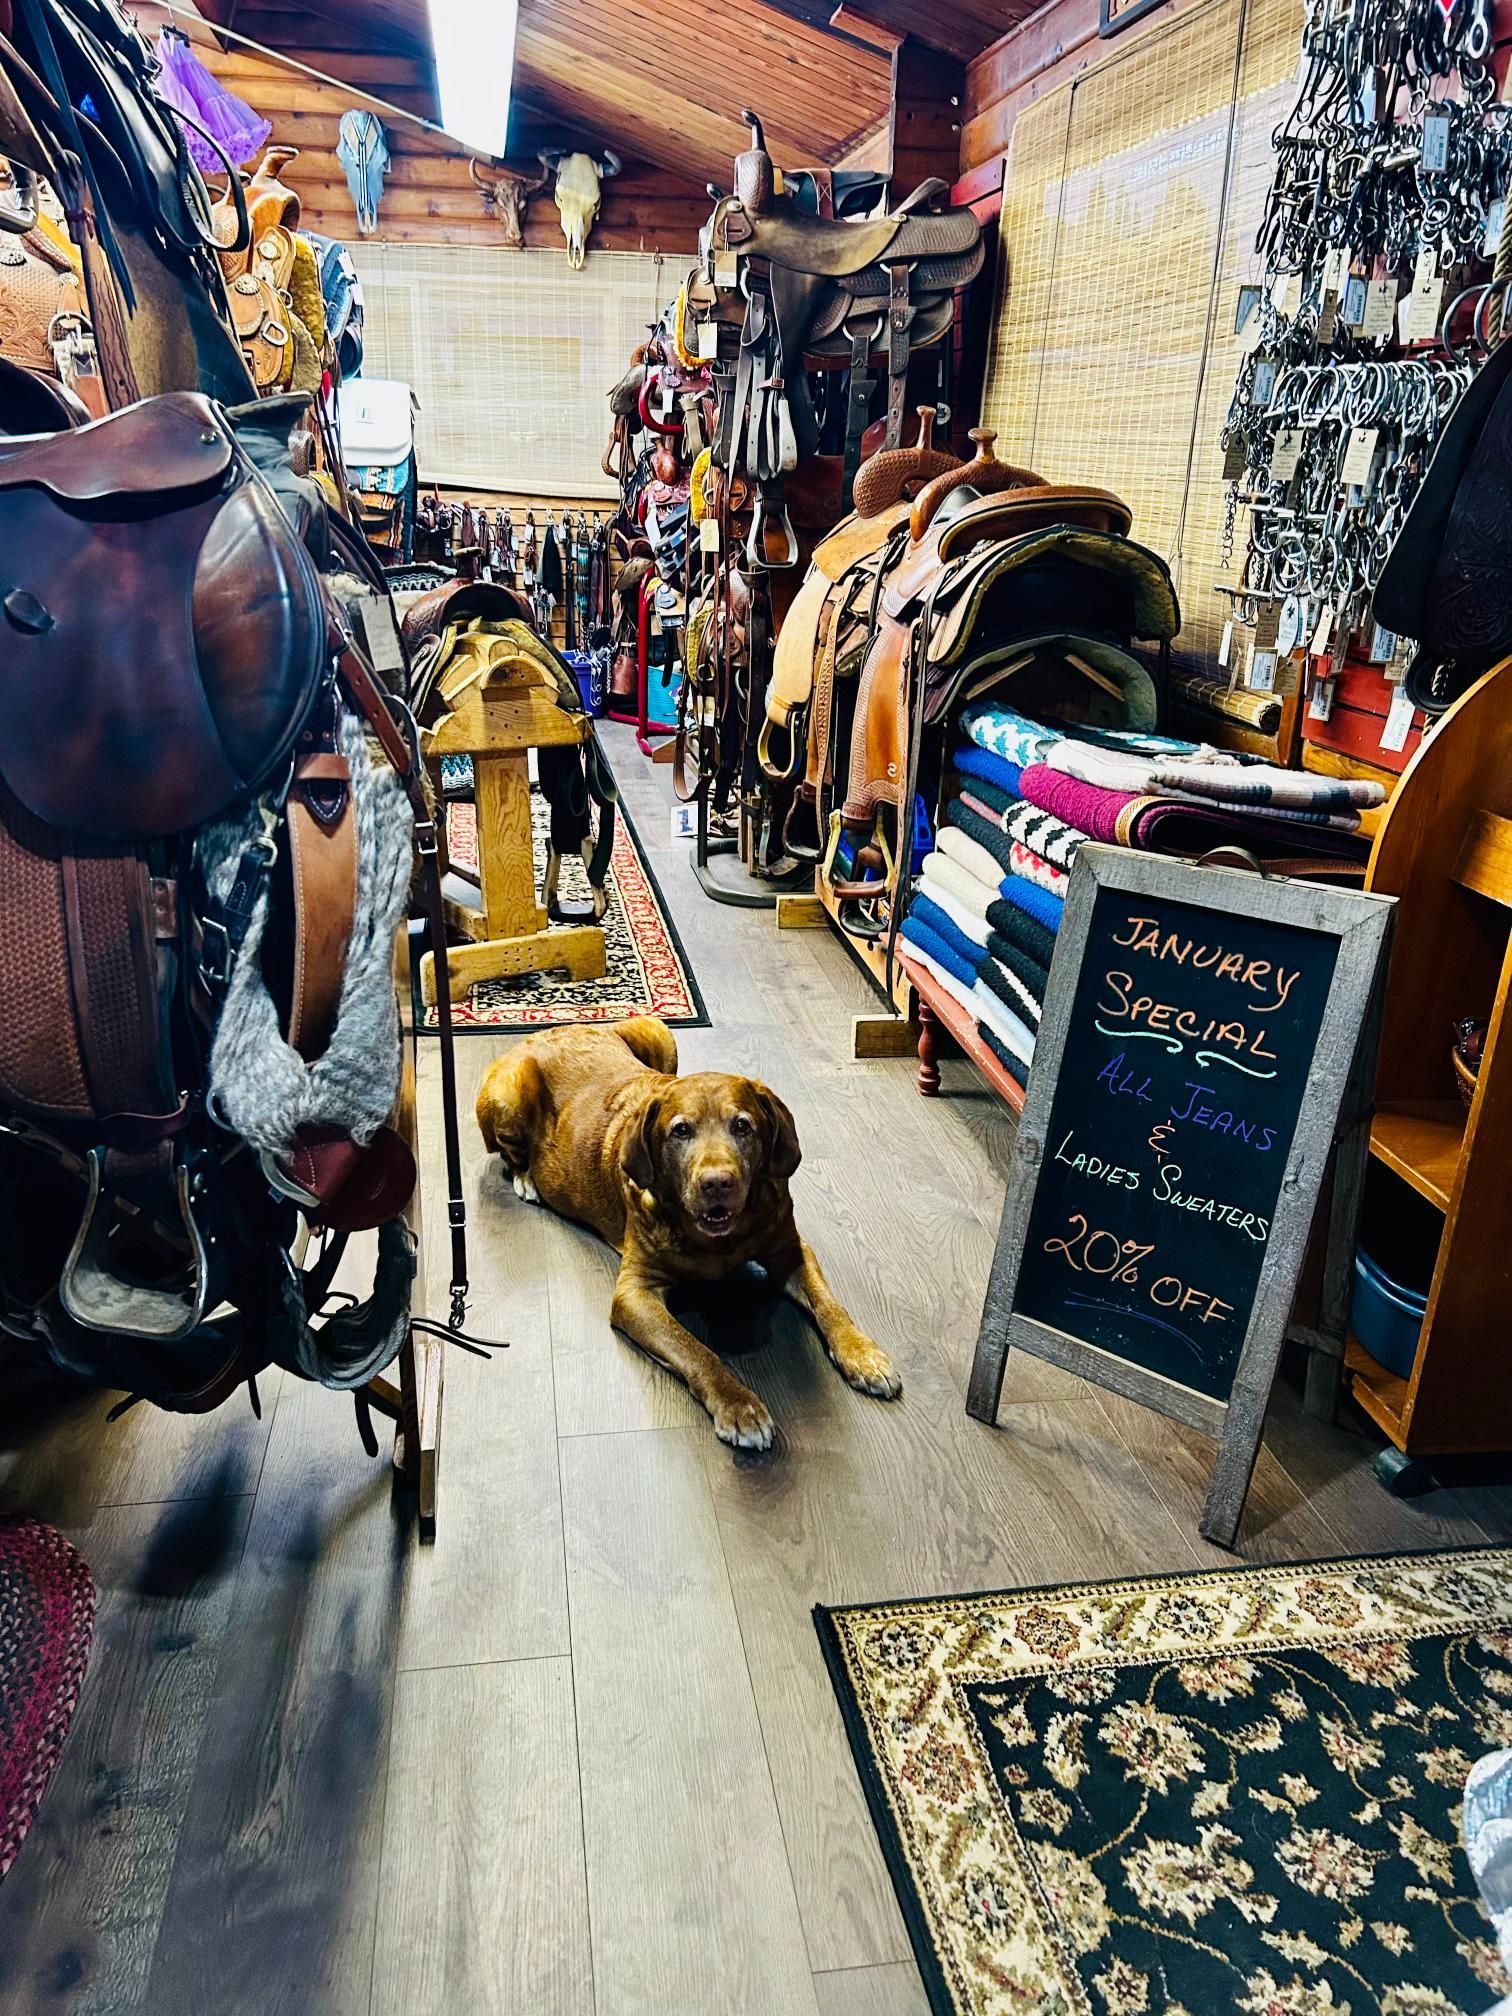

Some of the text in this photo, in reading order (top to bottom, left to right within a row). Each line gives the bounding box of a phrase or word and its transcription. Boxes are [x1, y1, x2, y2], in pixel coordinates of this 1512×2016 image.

[1112, 917, 1300, 1011] JANUARY
[1097, 971, 1277, 1059] SPECIAL
[1097, 1053, 1278, 1150] ALL JEANS
[1148, 1119, 1176, 1164] &
[1054, 1130, 1269, 1241] LADIES SWEATERS
[1044, 1214, 1235, 1323] 20% OFF
